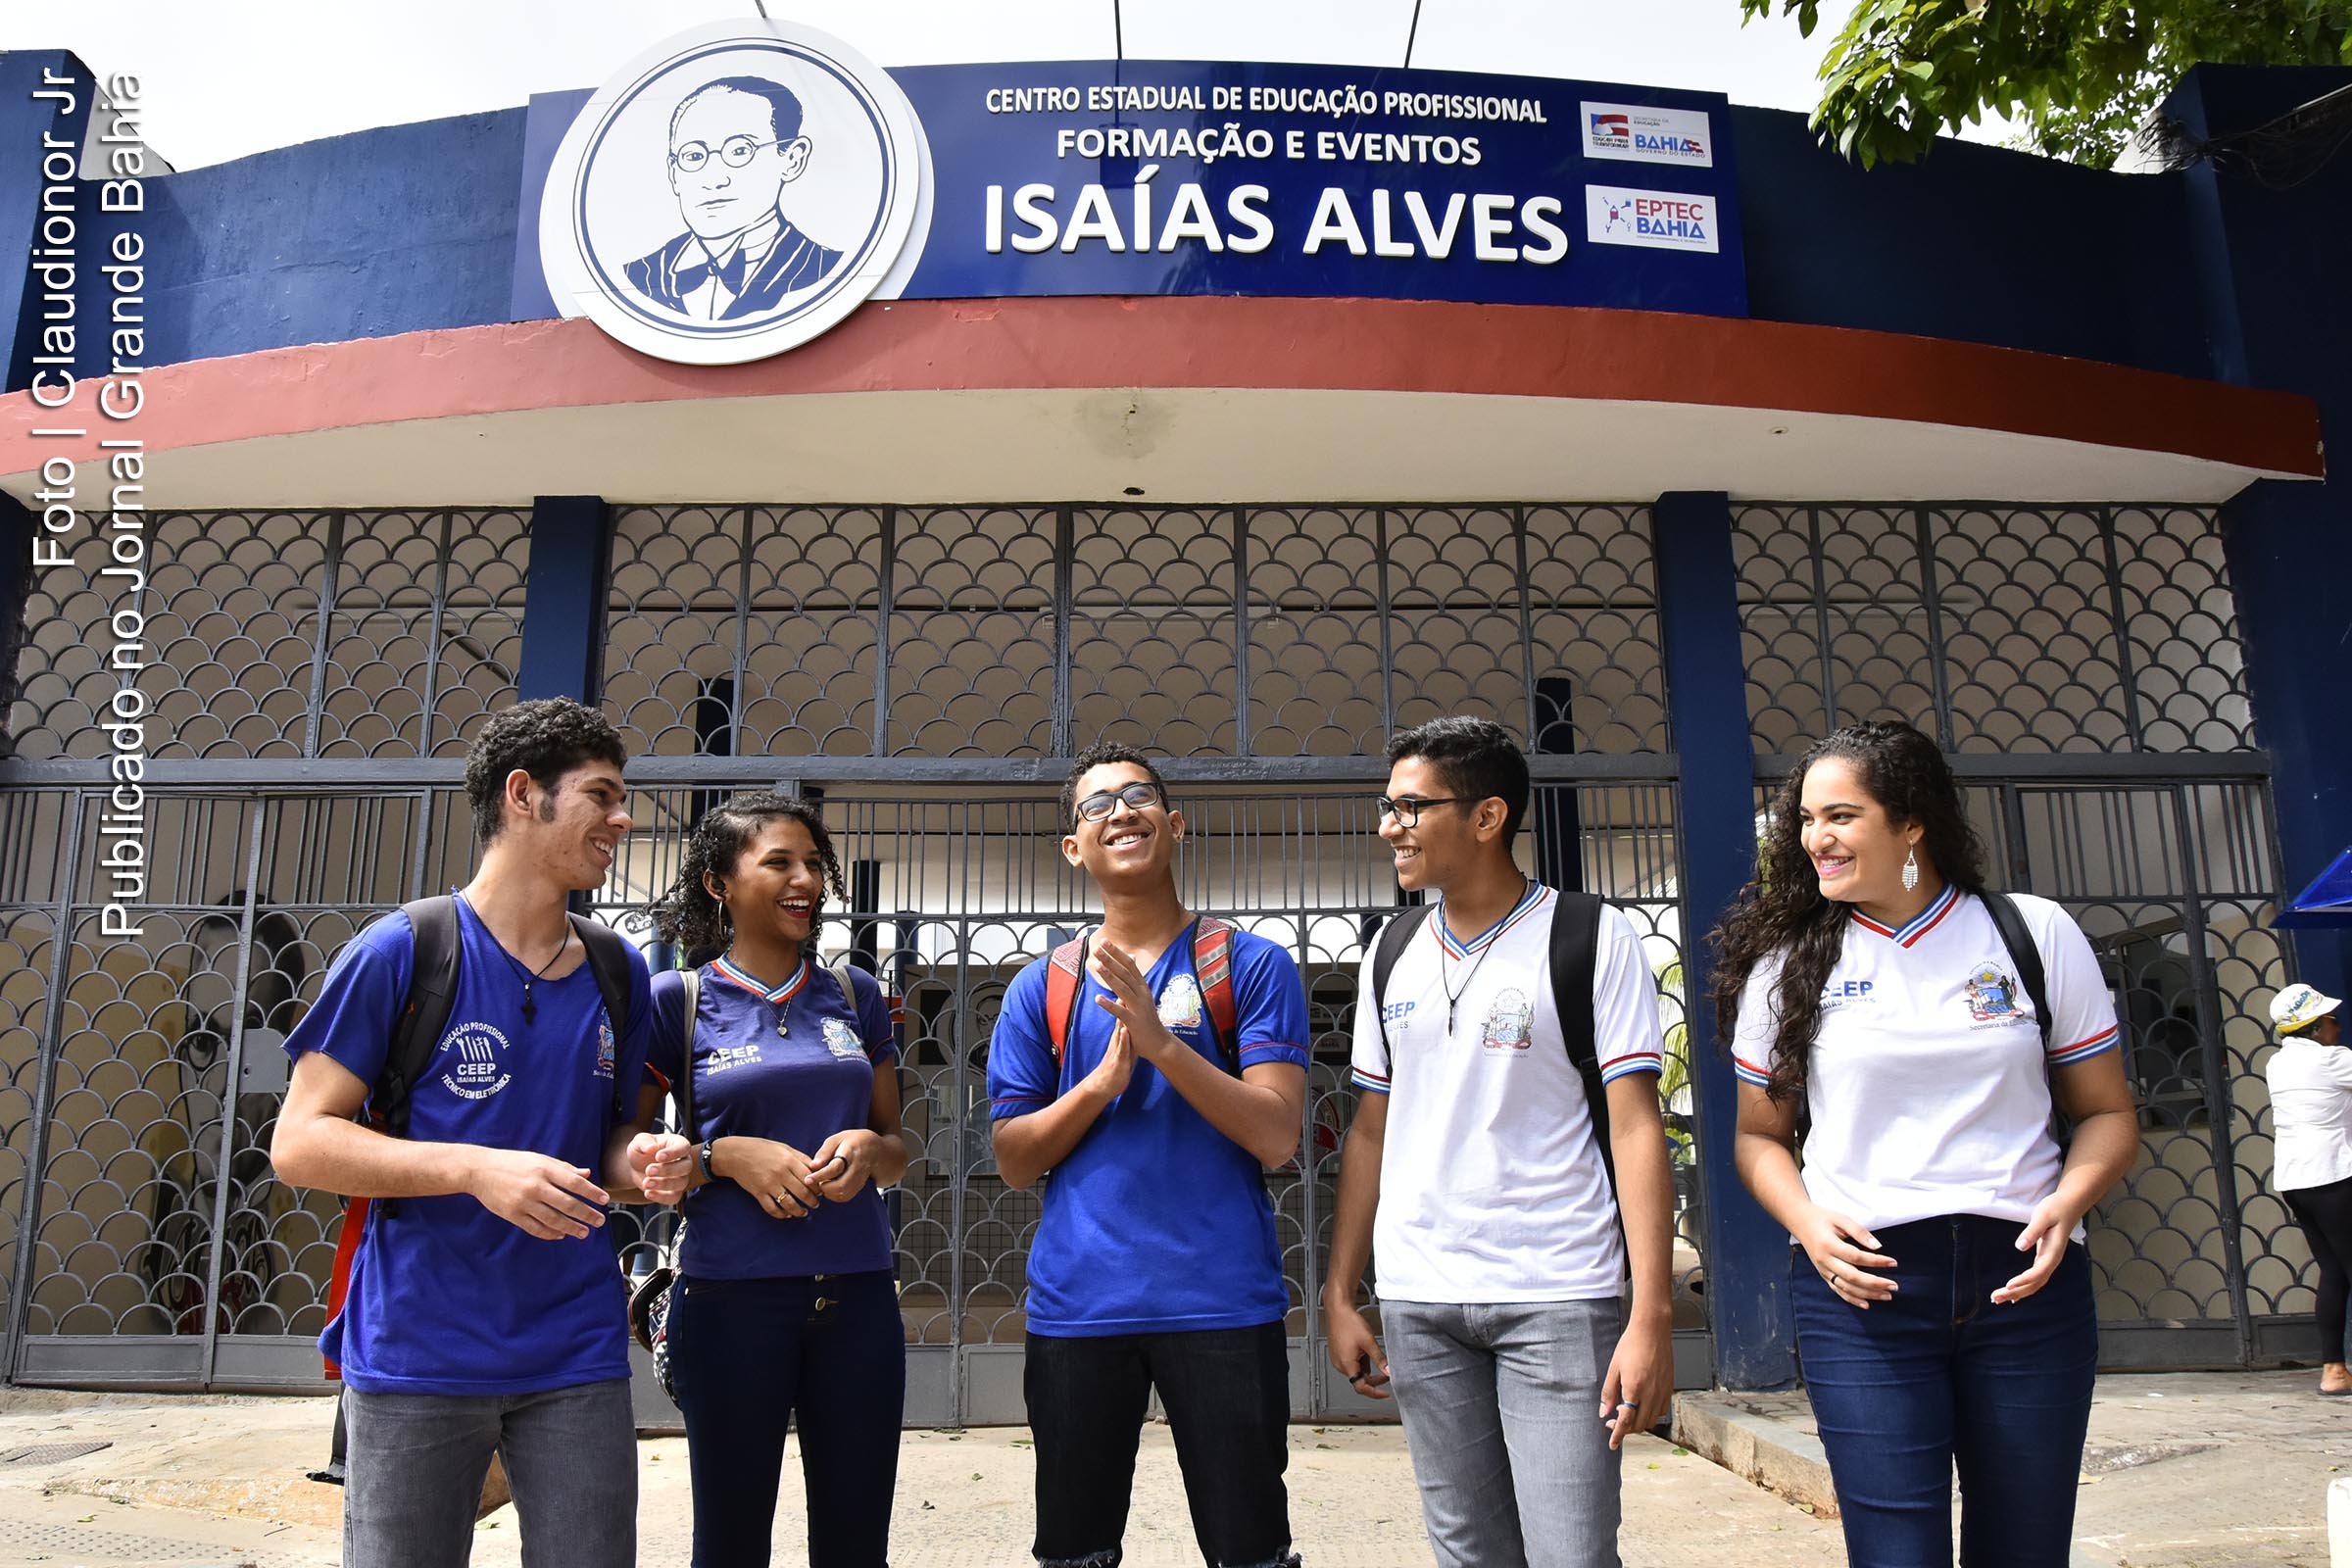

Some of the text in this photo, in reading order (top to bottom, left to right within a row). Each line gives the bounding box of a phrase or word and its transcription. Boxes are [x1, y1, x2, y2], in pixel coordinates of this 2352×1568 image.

[986, 84, 1547, 123] CENTRO ESTADUAL DE EDUCAÇÃO PROFISSIONAL
[1057, 122, 1482, 166] FORMAÇÃO E EVENTOS
[1635, 133, 1693, 152] BAHIA
[985, 164, 1568, 264] ISAÍAS ALVES
[1636, 198, 1704, 220] EPTEC
[1637, 217, 1706, 239] BAHIA
[440, 1021, 511, 1052] EDUCAÇÃO PROFISSIONAL
[708, 1045, 760, 1065] CEEP
[734, 1055, 762, 1067] ALVES
[457, 1062, 496, 1076] CEEP
[465, 1090, 475, 1100] EM
